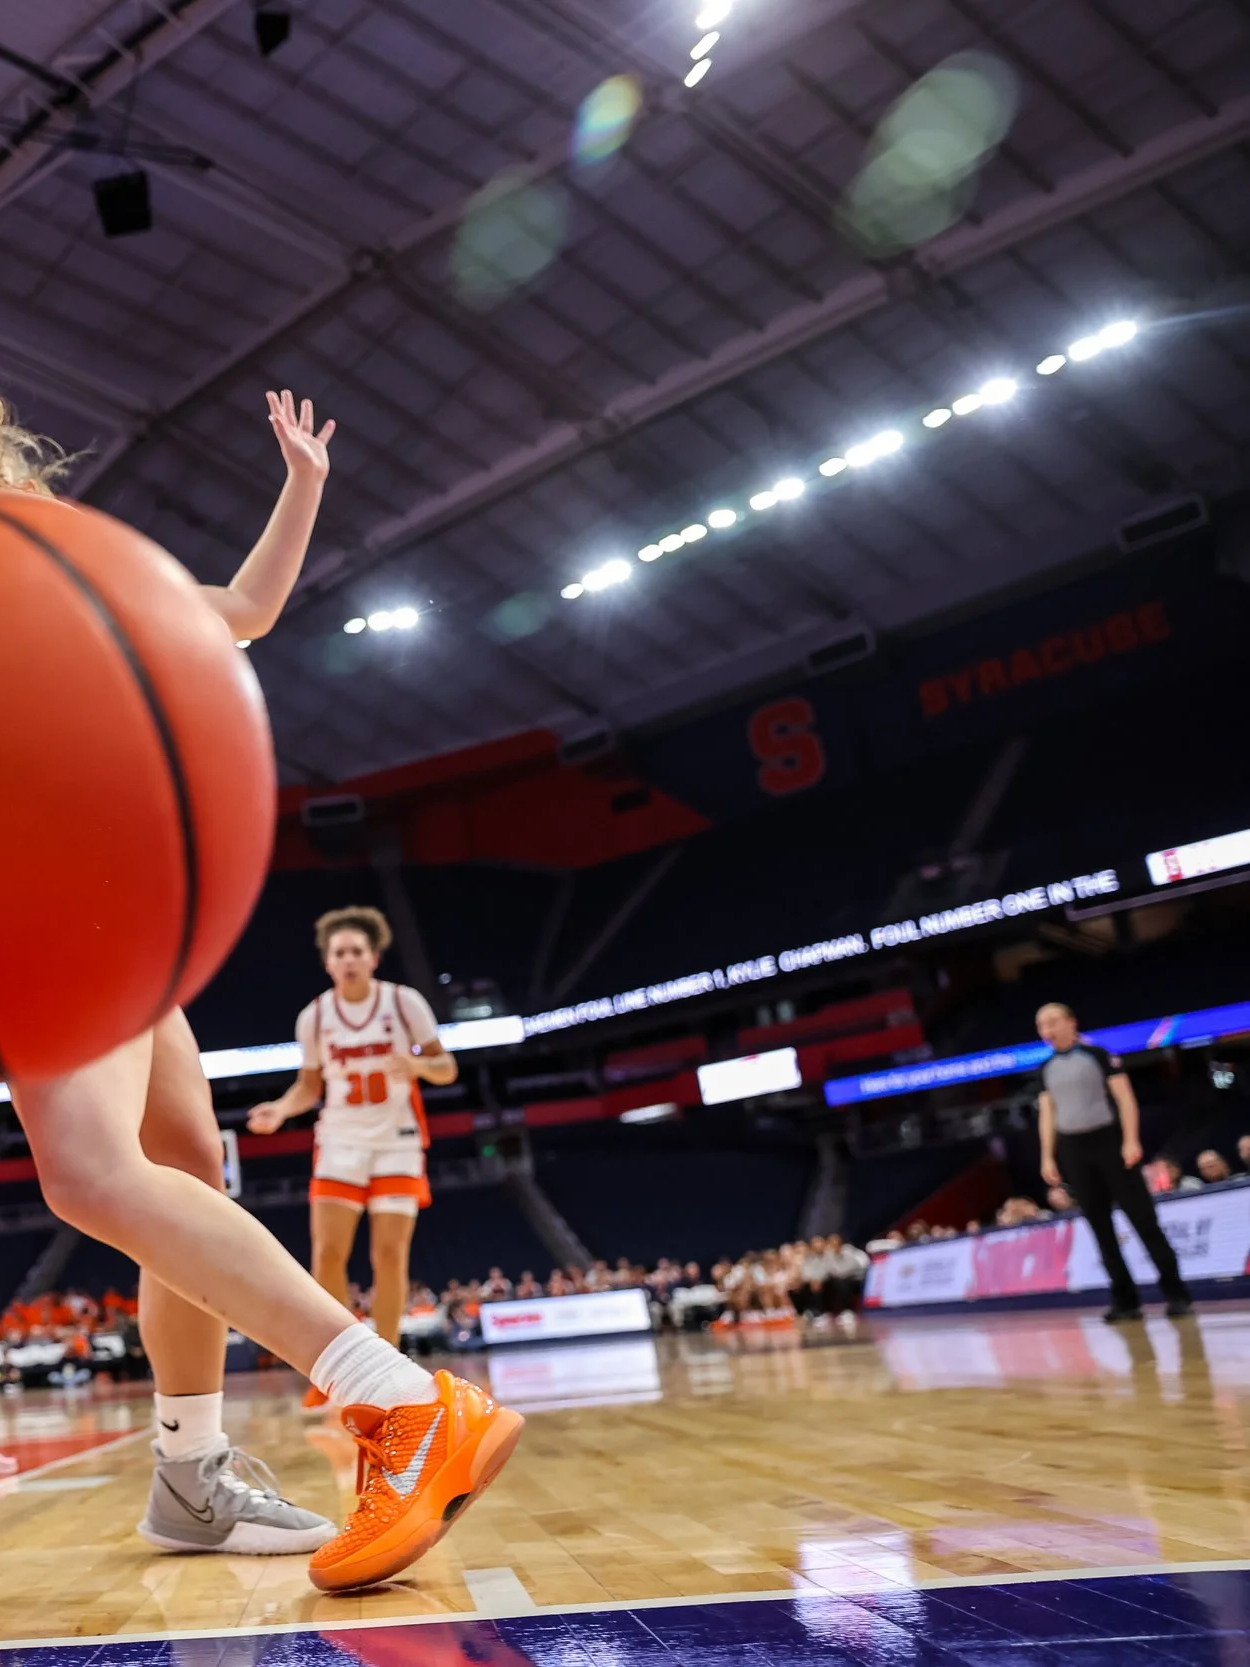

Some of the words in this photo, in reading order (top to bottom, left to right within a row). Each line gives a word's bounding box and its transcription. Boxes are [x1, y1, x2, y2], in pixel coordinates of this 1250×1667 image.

[918, 601, 1171, 719] SYRACUSE
[747, 695, 827, 797] S
[576, 997, 614, 1024] FOUL
[647, 971, 715, 1006] NUMBER
[871, 919, 922, 950] FOUL
[919, 898, 1003, 938] NUMBER
[1001, 886, 1050, 917] ONE
[1047, 880, 1075, 906] IN
[1071, 869, 1120, 898] THE
